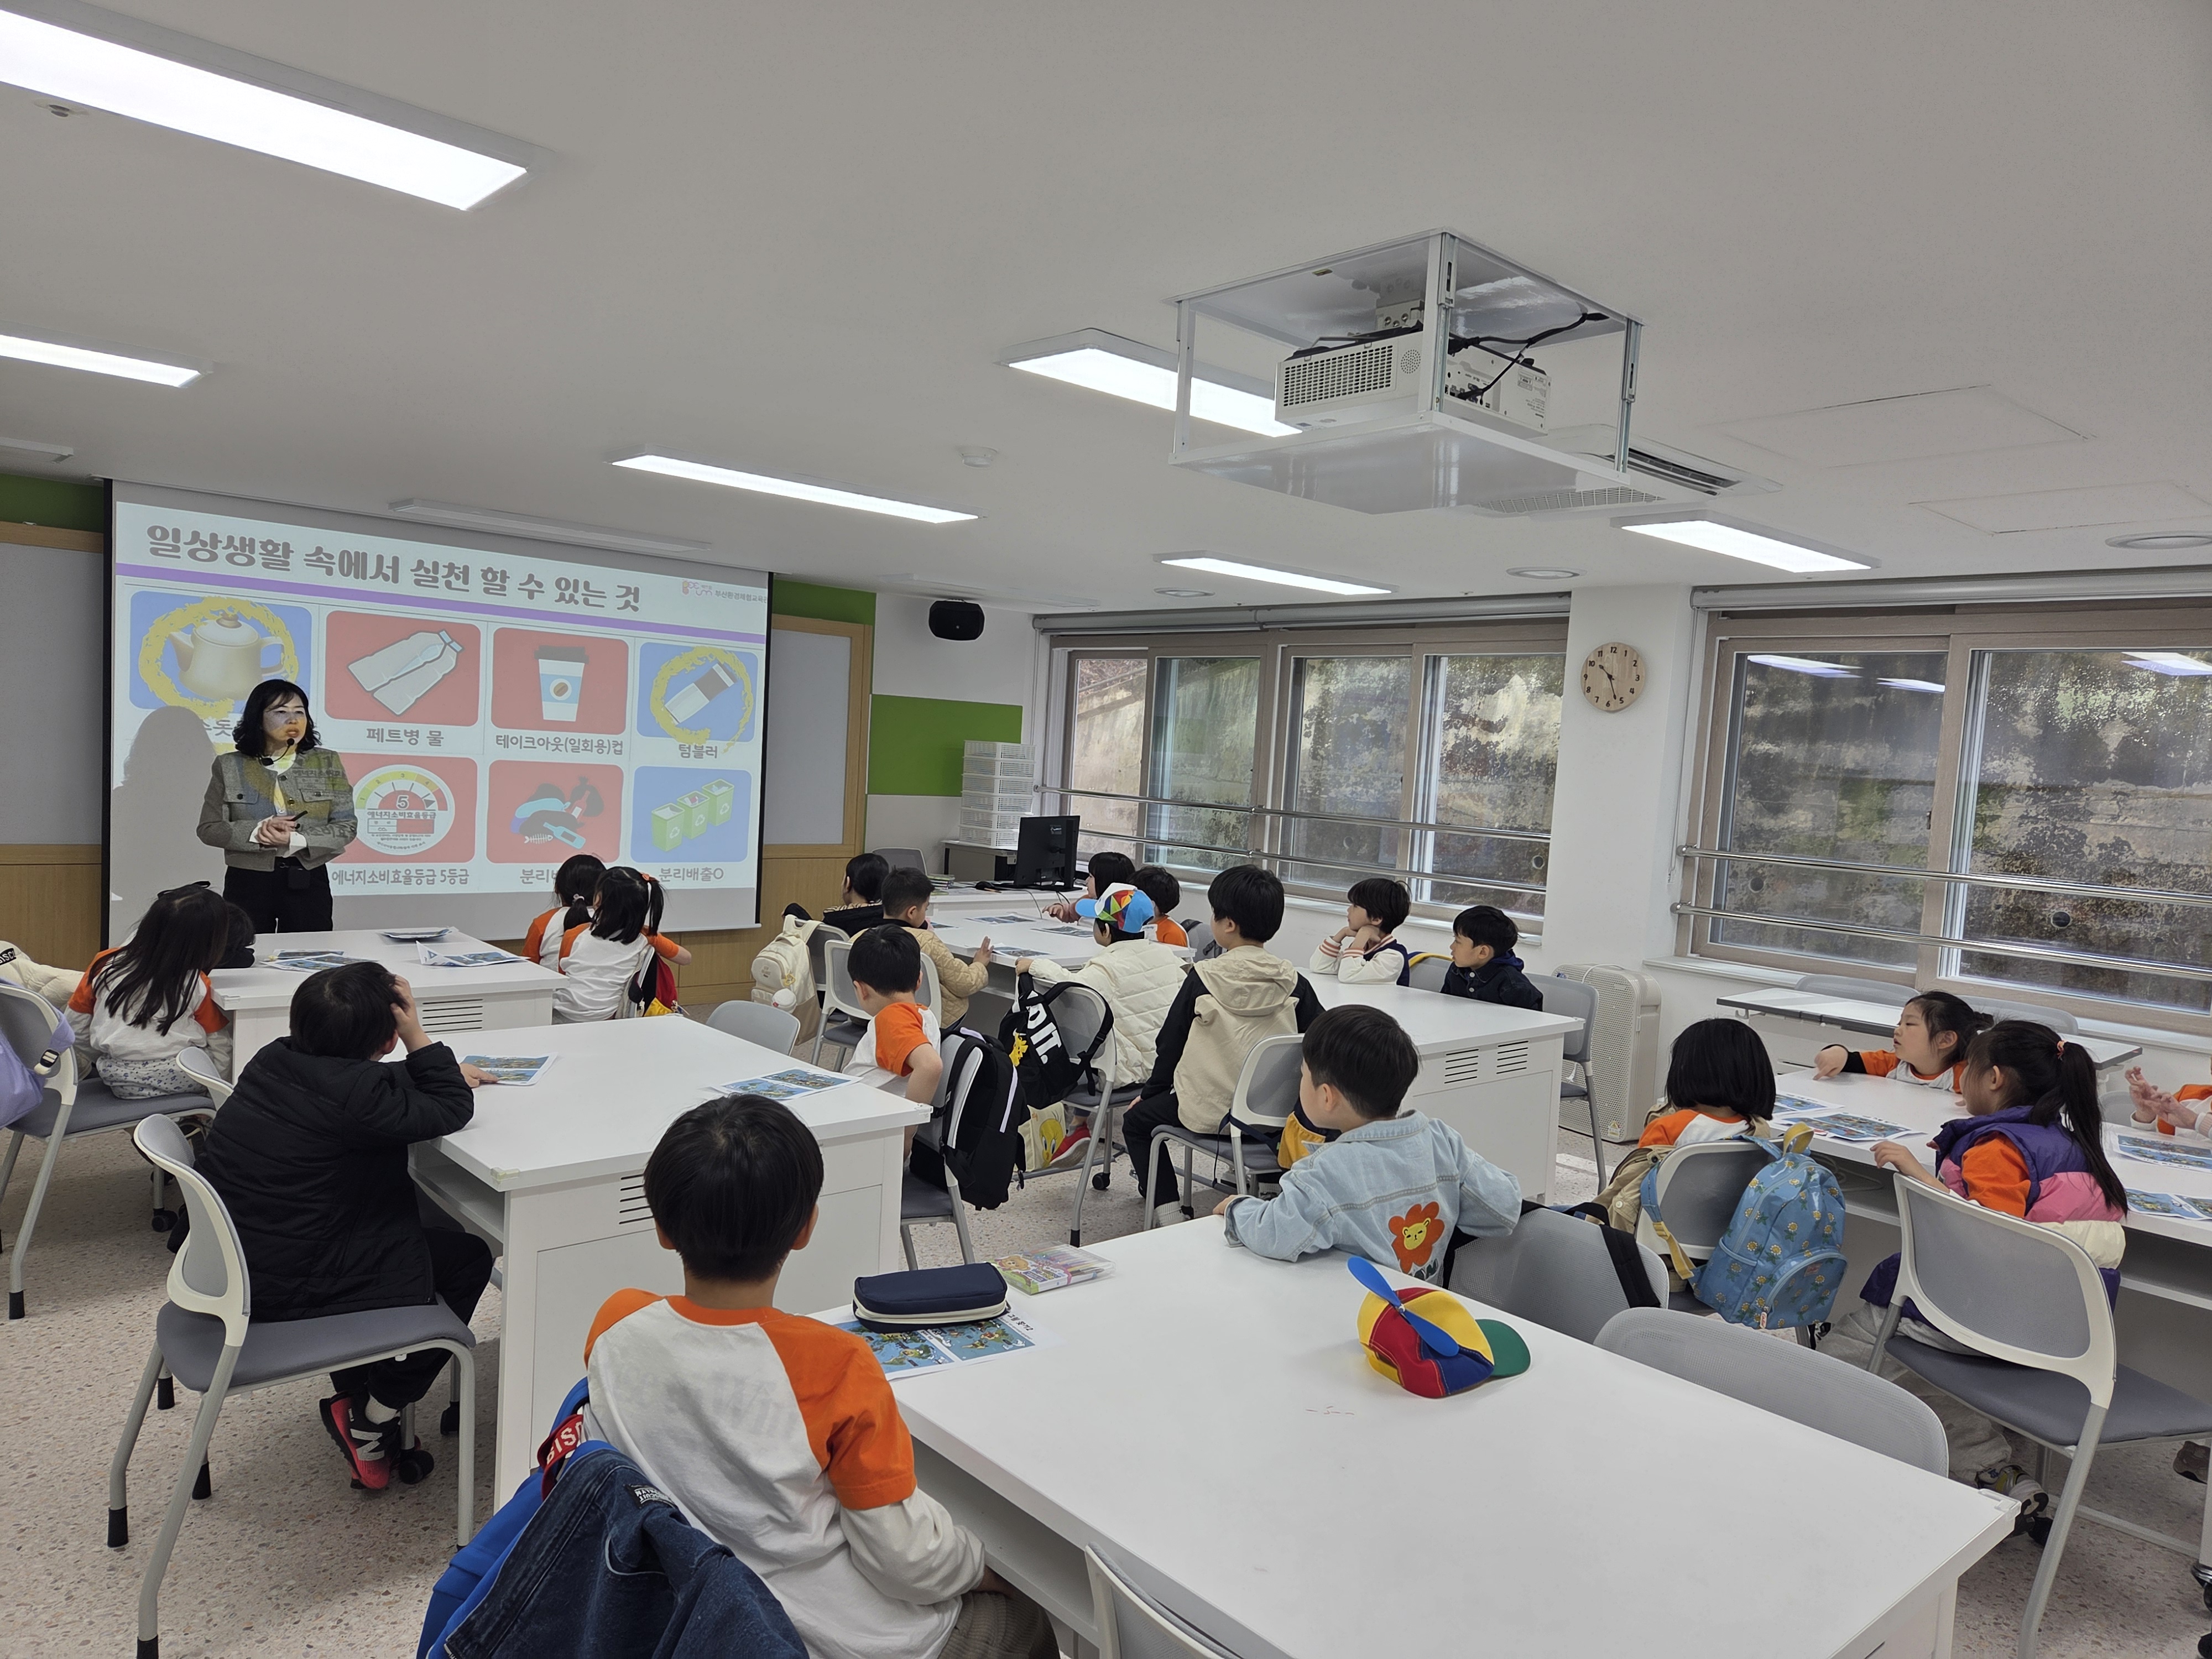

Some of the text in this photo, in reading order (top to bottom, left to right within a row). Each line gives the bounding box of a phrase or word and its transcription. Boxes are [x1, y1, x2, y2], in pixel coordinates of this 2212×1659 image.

[147, 525, 640, 612] 일상생활 속에서 실천 할 수 있는 것
[366, 728, 444, 747] 페트병 물
[495, 734, 623, 755] 테이크아웃(일회용)컵
[678, 743, 718, 759] 텀블러
[397, 796, 408, 809] 5
[332, 868, 469, 885] 에너지소비효율등급 5등급
[520, 869, 556, 885] 분리
